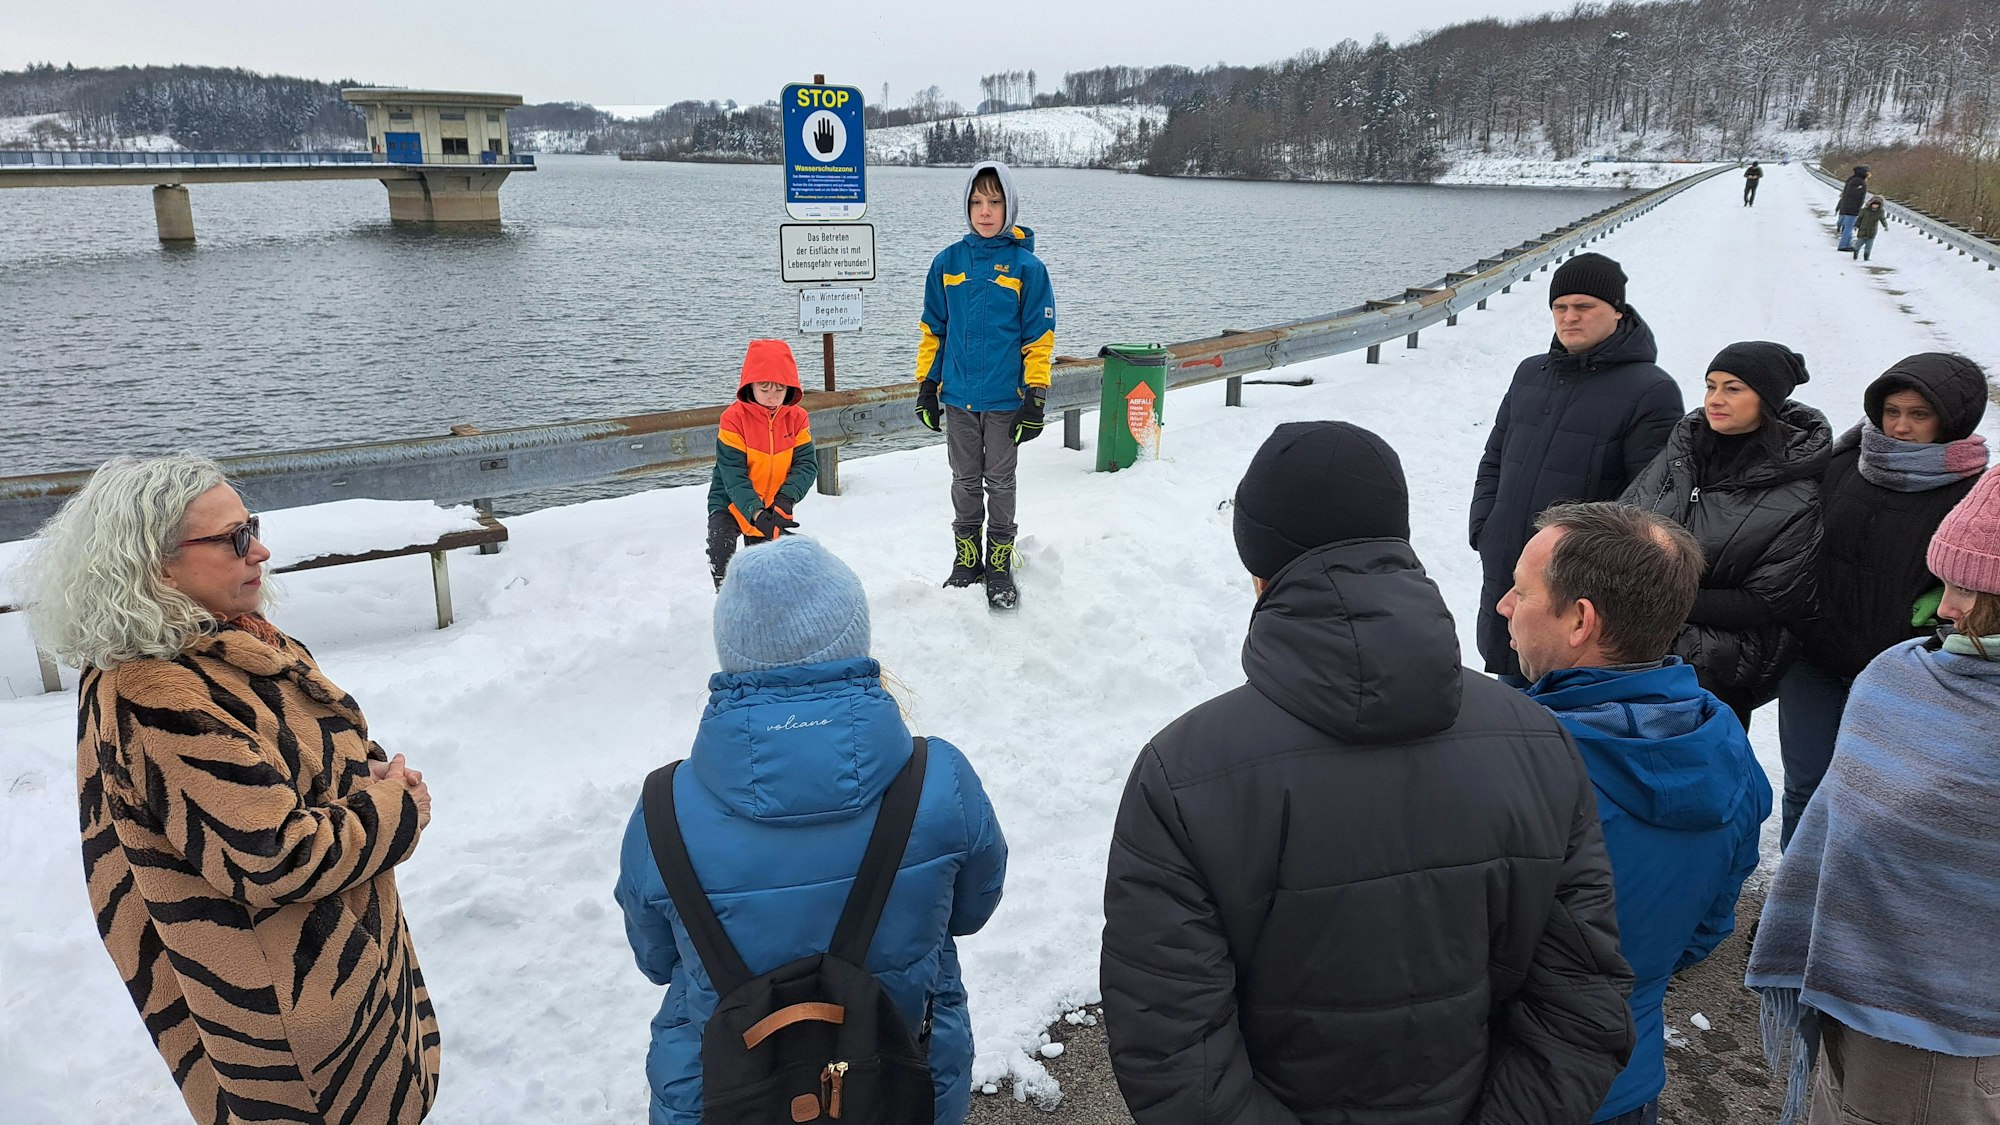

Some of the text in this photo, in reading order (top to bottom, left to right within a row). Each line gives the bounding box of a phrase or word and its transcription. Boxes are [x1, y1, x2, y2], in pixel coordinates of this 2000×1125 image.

[797, 88, 849, 108] STOP
[794, 164, 853, 173] Wasserschutzzone
[807, 233, 849, 242] Das Betreten
[796, 246, 861, 255] der Eisfläche ist mit
[787, 258, 870, 270] Lebensgefahr verbunden!
[802, 292, 860, 302] Kein Winterdienst
[815, 306, 848, 316] Begehen
[802, 317, 860, 328] auf eigene Gefahr
[766, 714, 834, 732] volcano
